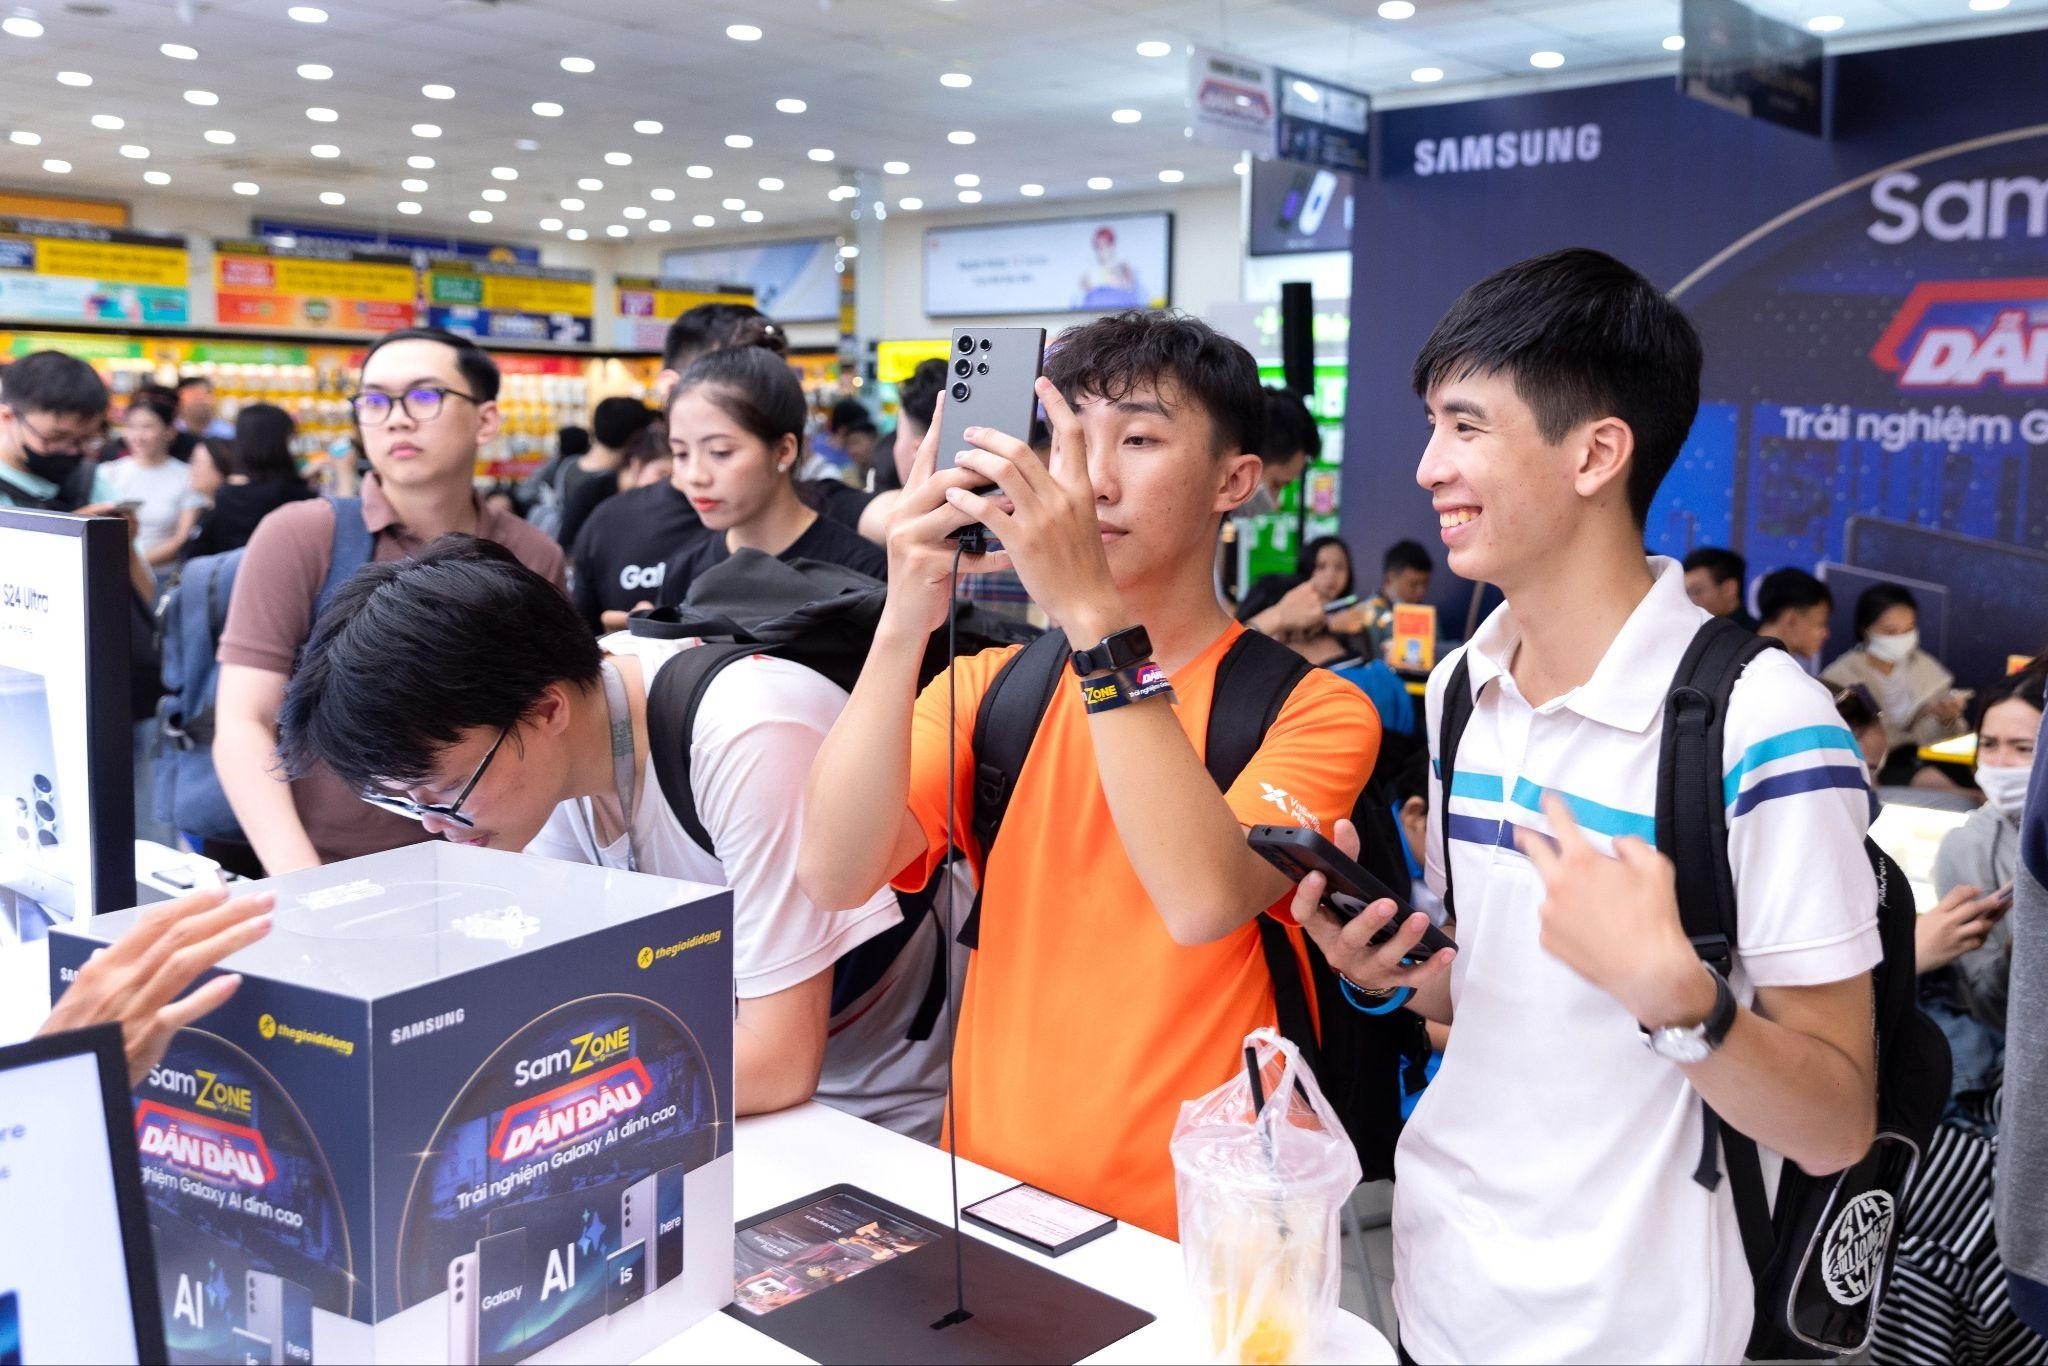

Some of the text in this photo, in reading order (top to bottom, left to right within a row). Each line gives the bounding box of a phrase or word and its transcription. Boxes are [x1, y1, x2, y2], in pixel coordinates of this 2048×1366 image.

[1413, 123, 1602, 176] SAMSUNG
[1780, 402, 1851, 440] Trải
[1856, 405, 2012, 453] nghiệm
[655, 929, 722, 959] thegioididong
[277, 1024, 354, 1056] thegioididong
[390, 1008, 465, 1046] SAMSUNG
[457, 1183, 488, 1209] Trải
[490, 1161, 549, 1196] nghiệm
[551, 1137, 602, 1168] Galaxy
[605, 1127, 619, 1146] AI
[651, 1105, 677, 1124] cao
[179, 1176, 227, 1209] Galaxy
[228, 1191, 242, 1209] AI
[274, 1207, 304, 1228] cao
[481, 1215, 681, 1310] Galaxy AI is here
[173, 1273, 204, 1329] AI
[286, 1340, 311, 1362] here
